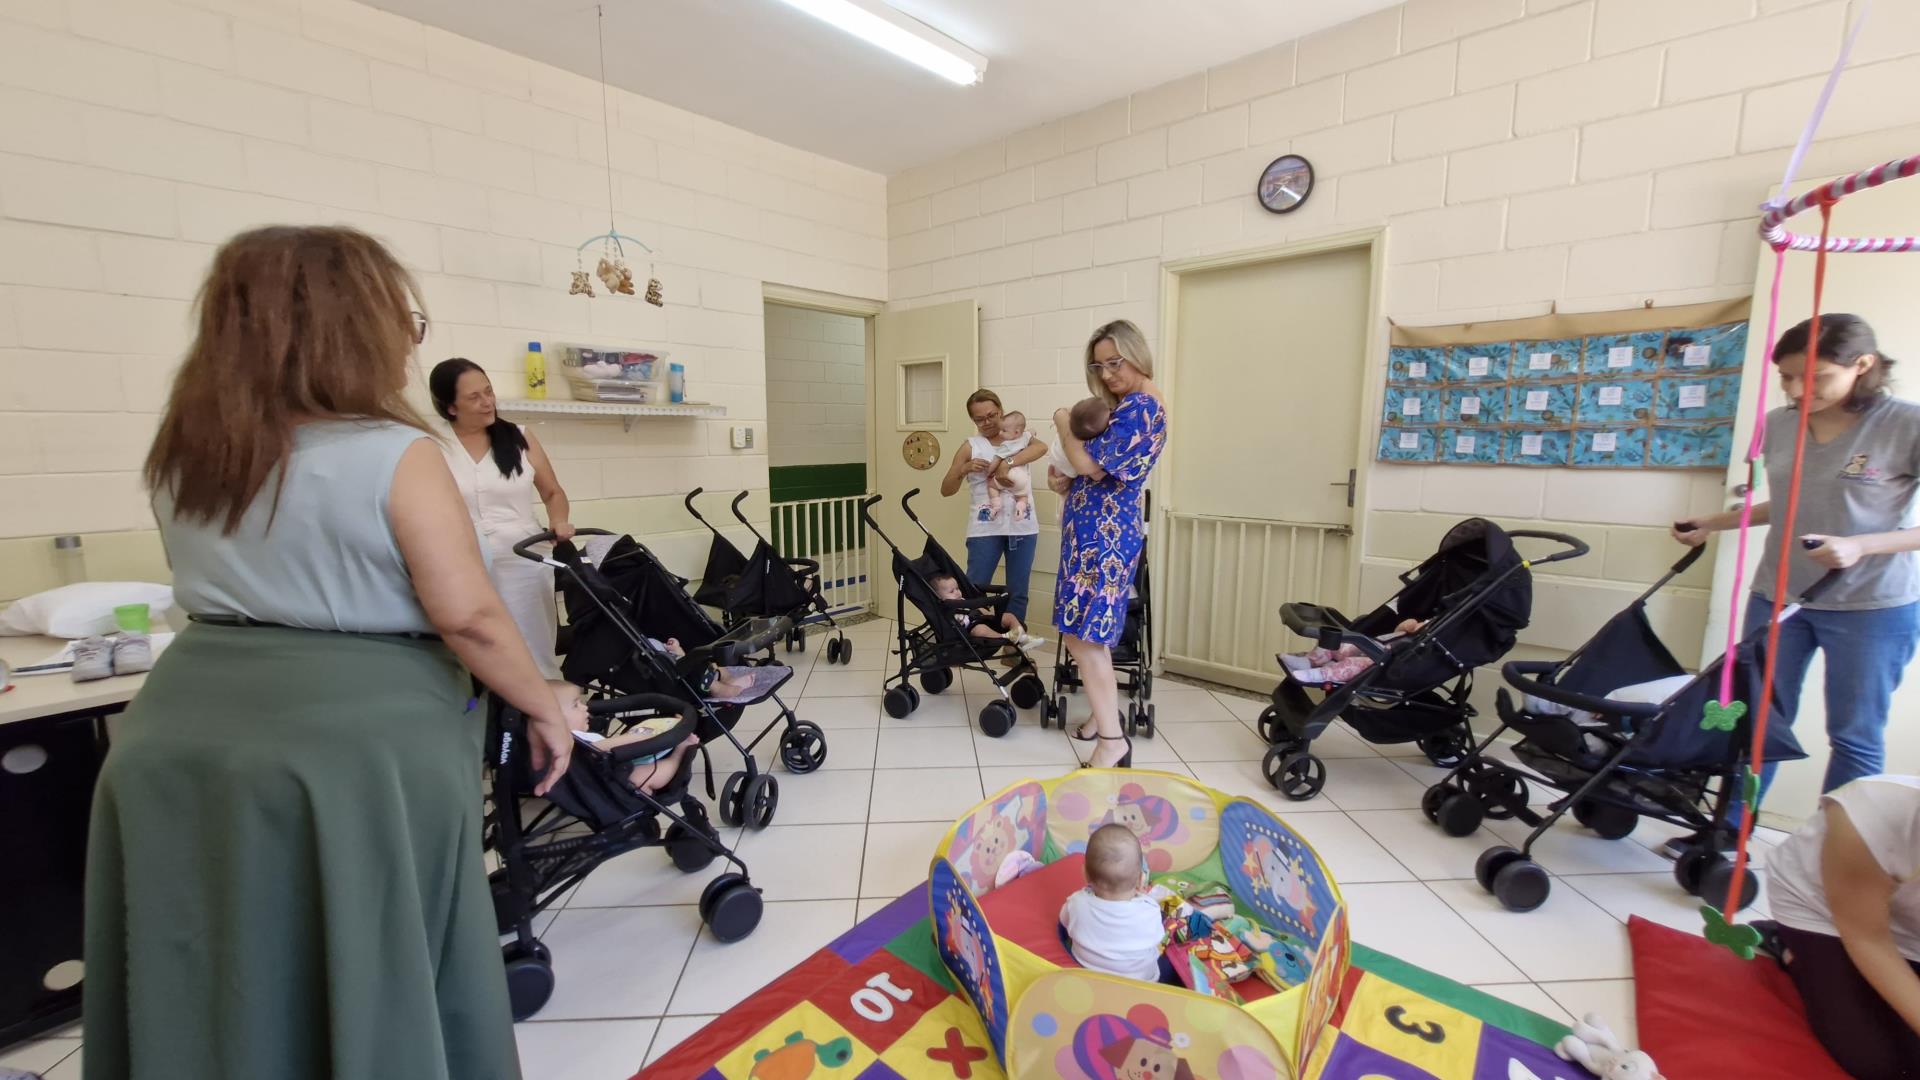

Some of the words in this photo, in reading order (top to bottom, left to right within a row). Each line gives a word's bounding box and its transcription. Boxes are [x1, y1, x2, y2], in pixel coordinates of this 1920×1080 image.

[500, 731, 512, 765] voyage
[850, 972, 913, 1022] 10
[1384, 1005, 1446, 1044] 3
